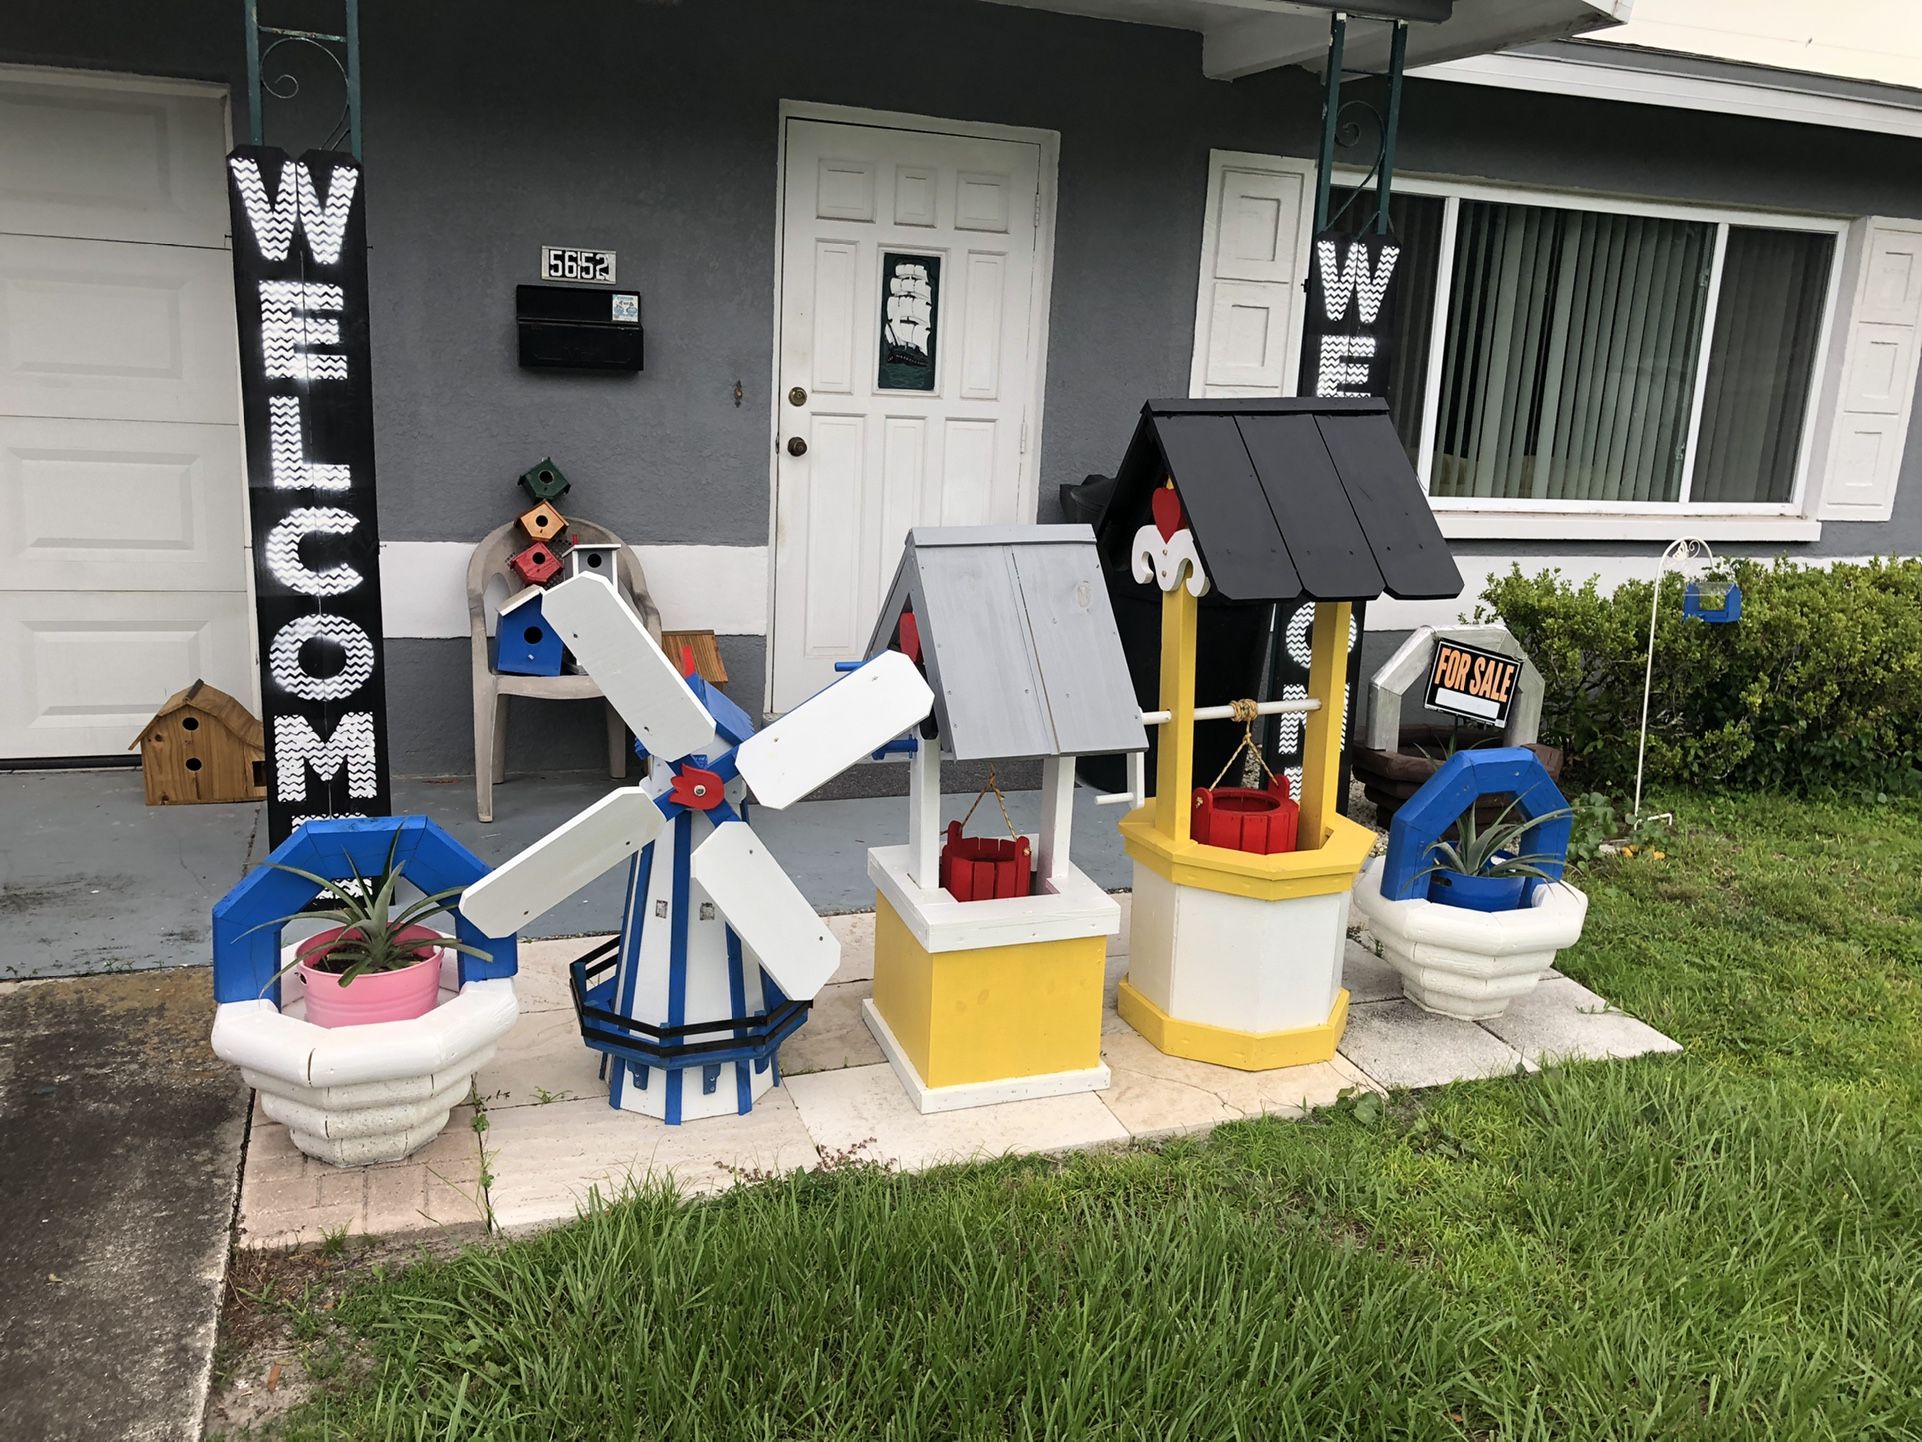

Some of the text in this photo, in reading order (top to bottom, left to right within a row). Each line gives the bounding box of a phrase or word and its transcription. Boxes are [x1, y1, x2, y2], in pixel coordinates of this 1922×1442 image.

[550, 250, 609, 280] 5652
[1434, 647, 1515, 703] FOR SALE
